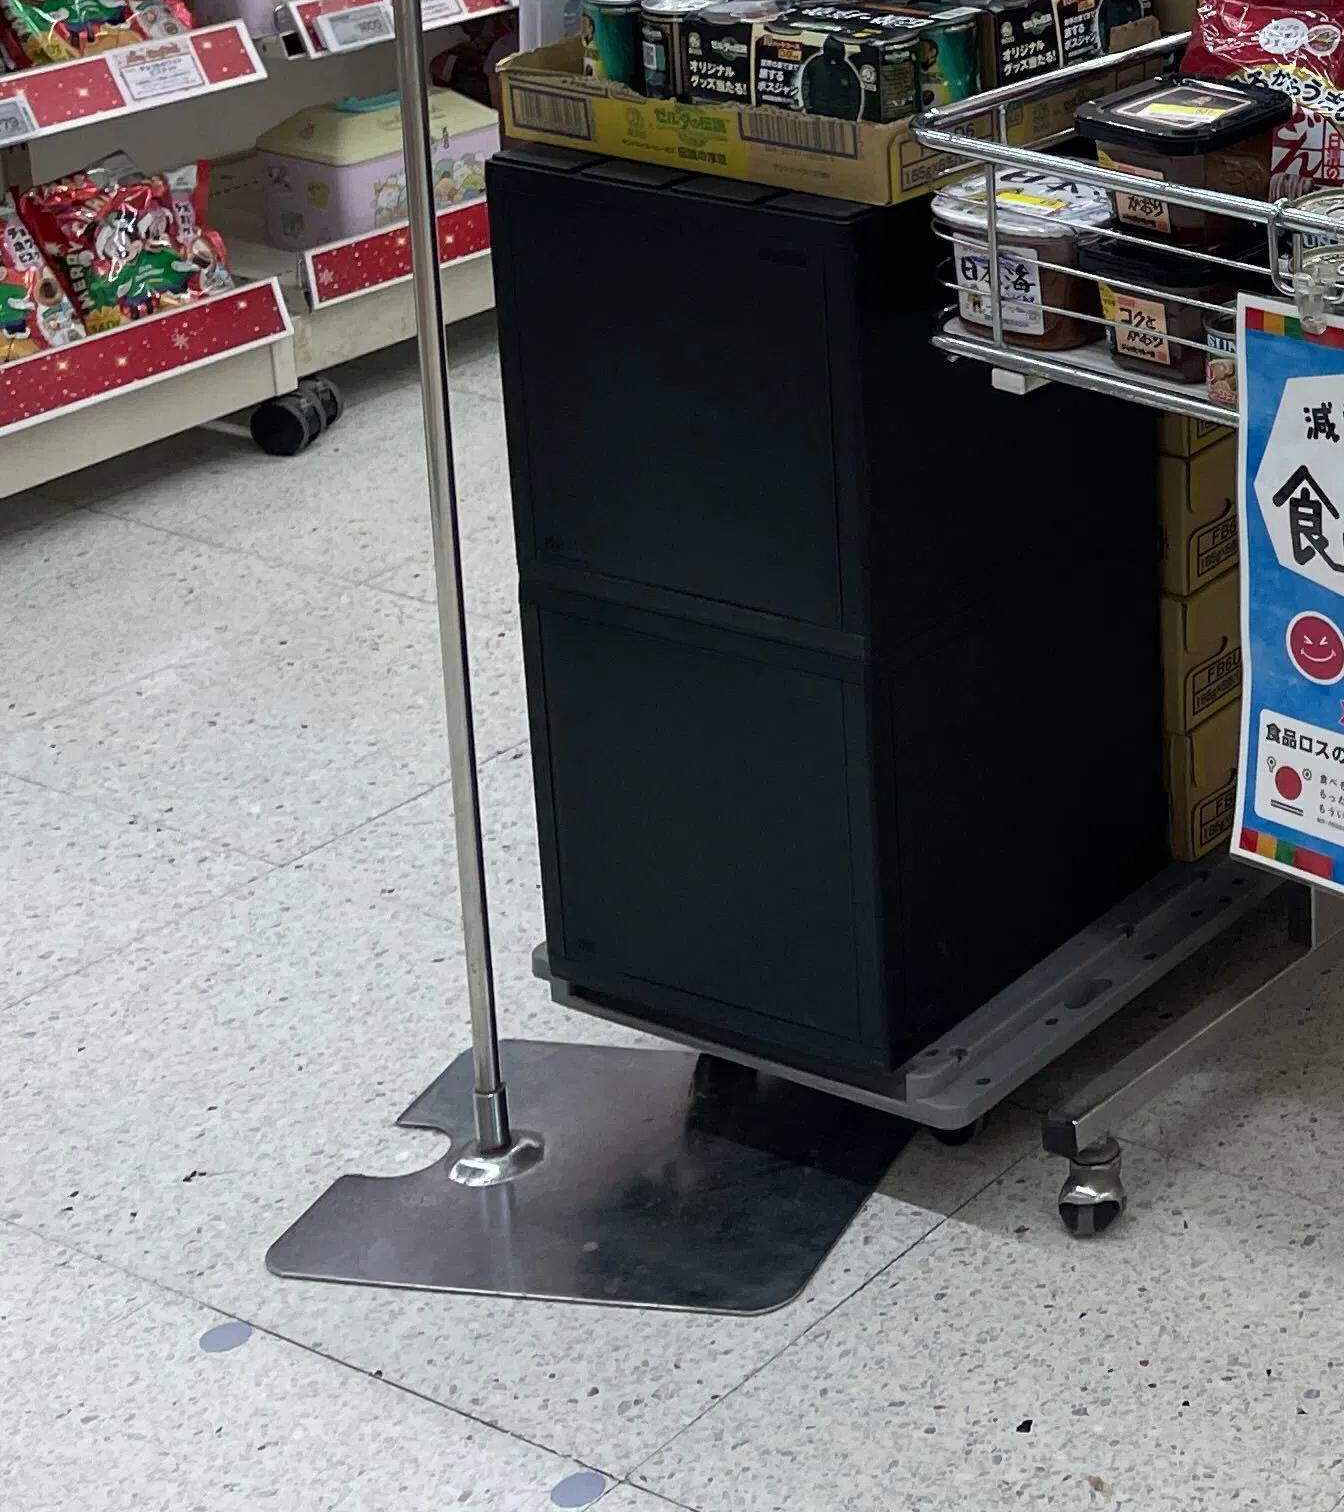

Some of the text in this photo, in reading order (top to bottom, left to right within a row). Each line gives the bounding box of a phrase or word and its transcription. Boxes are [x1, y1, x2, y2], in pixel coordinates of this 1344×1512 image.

[1001, 39, 1047, 63] オリジナル
[689, 60, 737, 78] オリジナル
[1003, 52, 1057, 76] グッズ当たる!
[689, 73, 747, 96] グッズ当たる!
[1126, 194, 1164, 218] かおり
[1117, 307, 1158, 332] コクと
[1126, 329, 1164, 349] かおり
